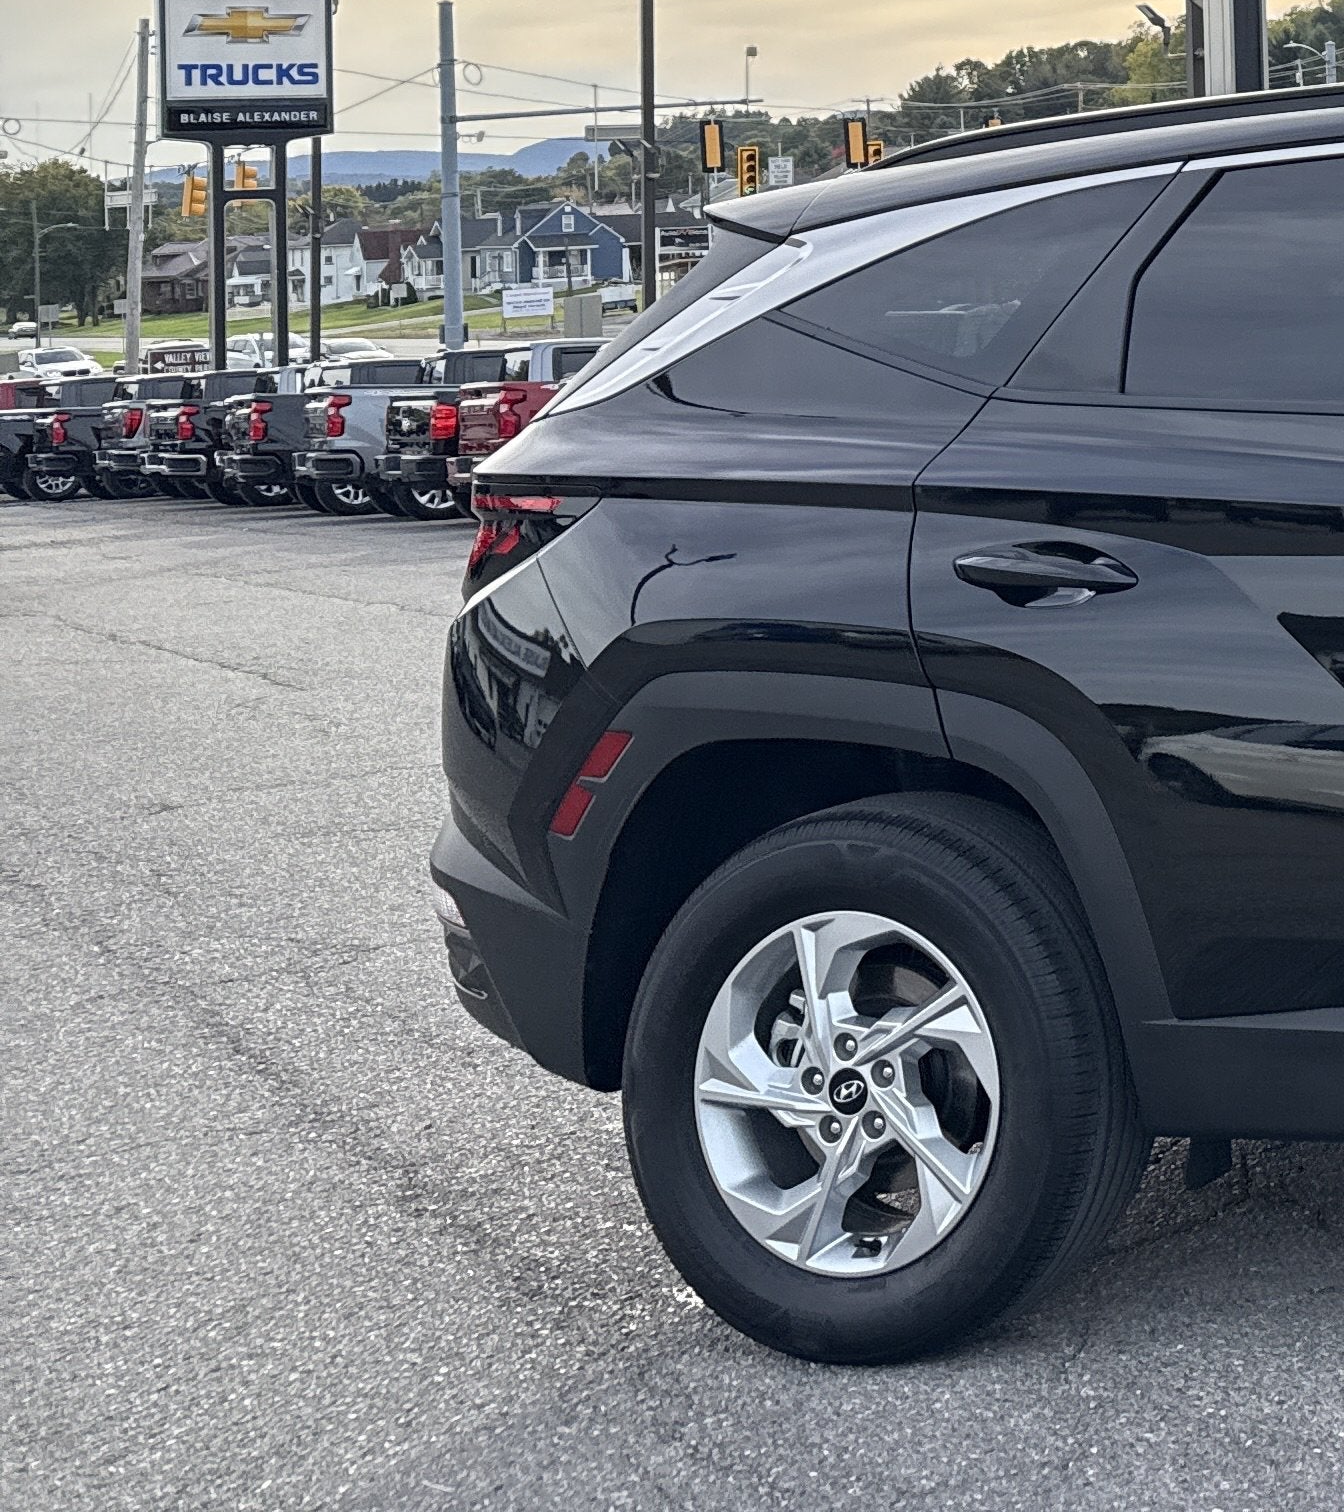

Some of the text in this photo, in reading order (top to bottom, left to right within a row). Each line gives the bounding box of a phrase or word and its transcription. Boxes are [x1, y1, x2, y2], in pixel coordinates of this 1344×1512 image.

[177, 62, 319, 86] TRUCKS
[180, 110, 318, 123] BLAISE ALEXANDER
[164, 353, 191, 364] VALLEY
